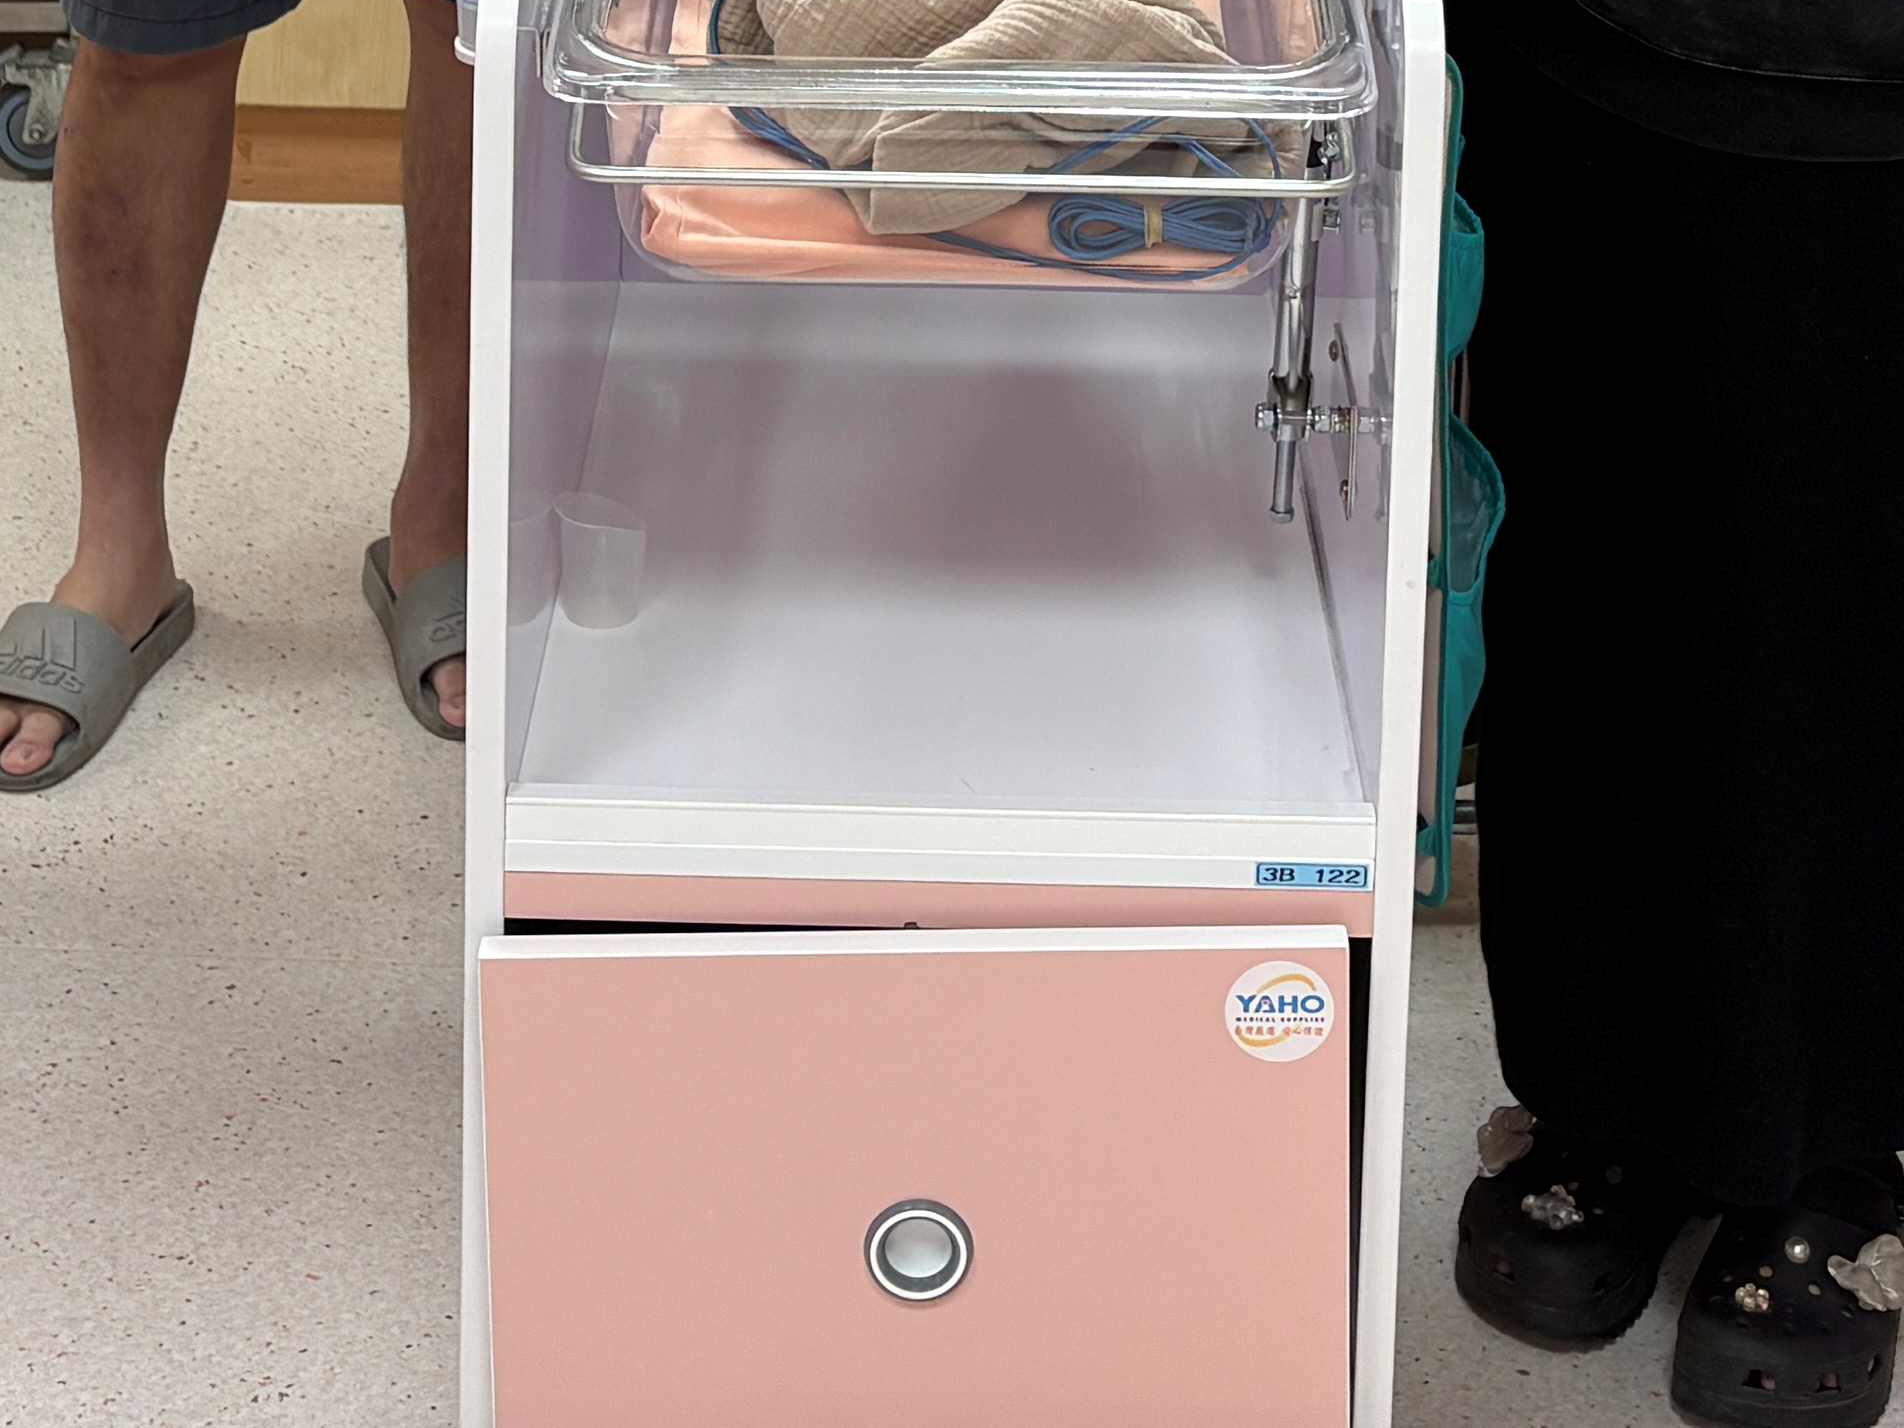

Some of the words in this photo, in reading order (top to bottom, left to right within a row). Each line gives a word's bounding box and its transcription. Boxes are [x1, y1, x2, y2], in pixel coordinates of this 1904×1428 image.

[1262, 867, 1296, 882] 3B
[1315, 869, 1361, 884] 122
[1235, 994, 1325, 1014] YAHO
